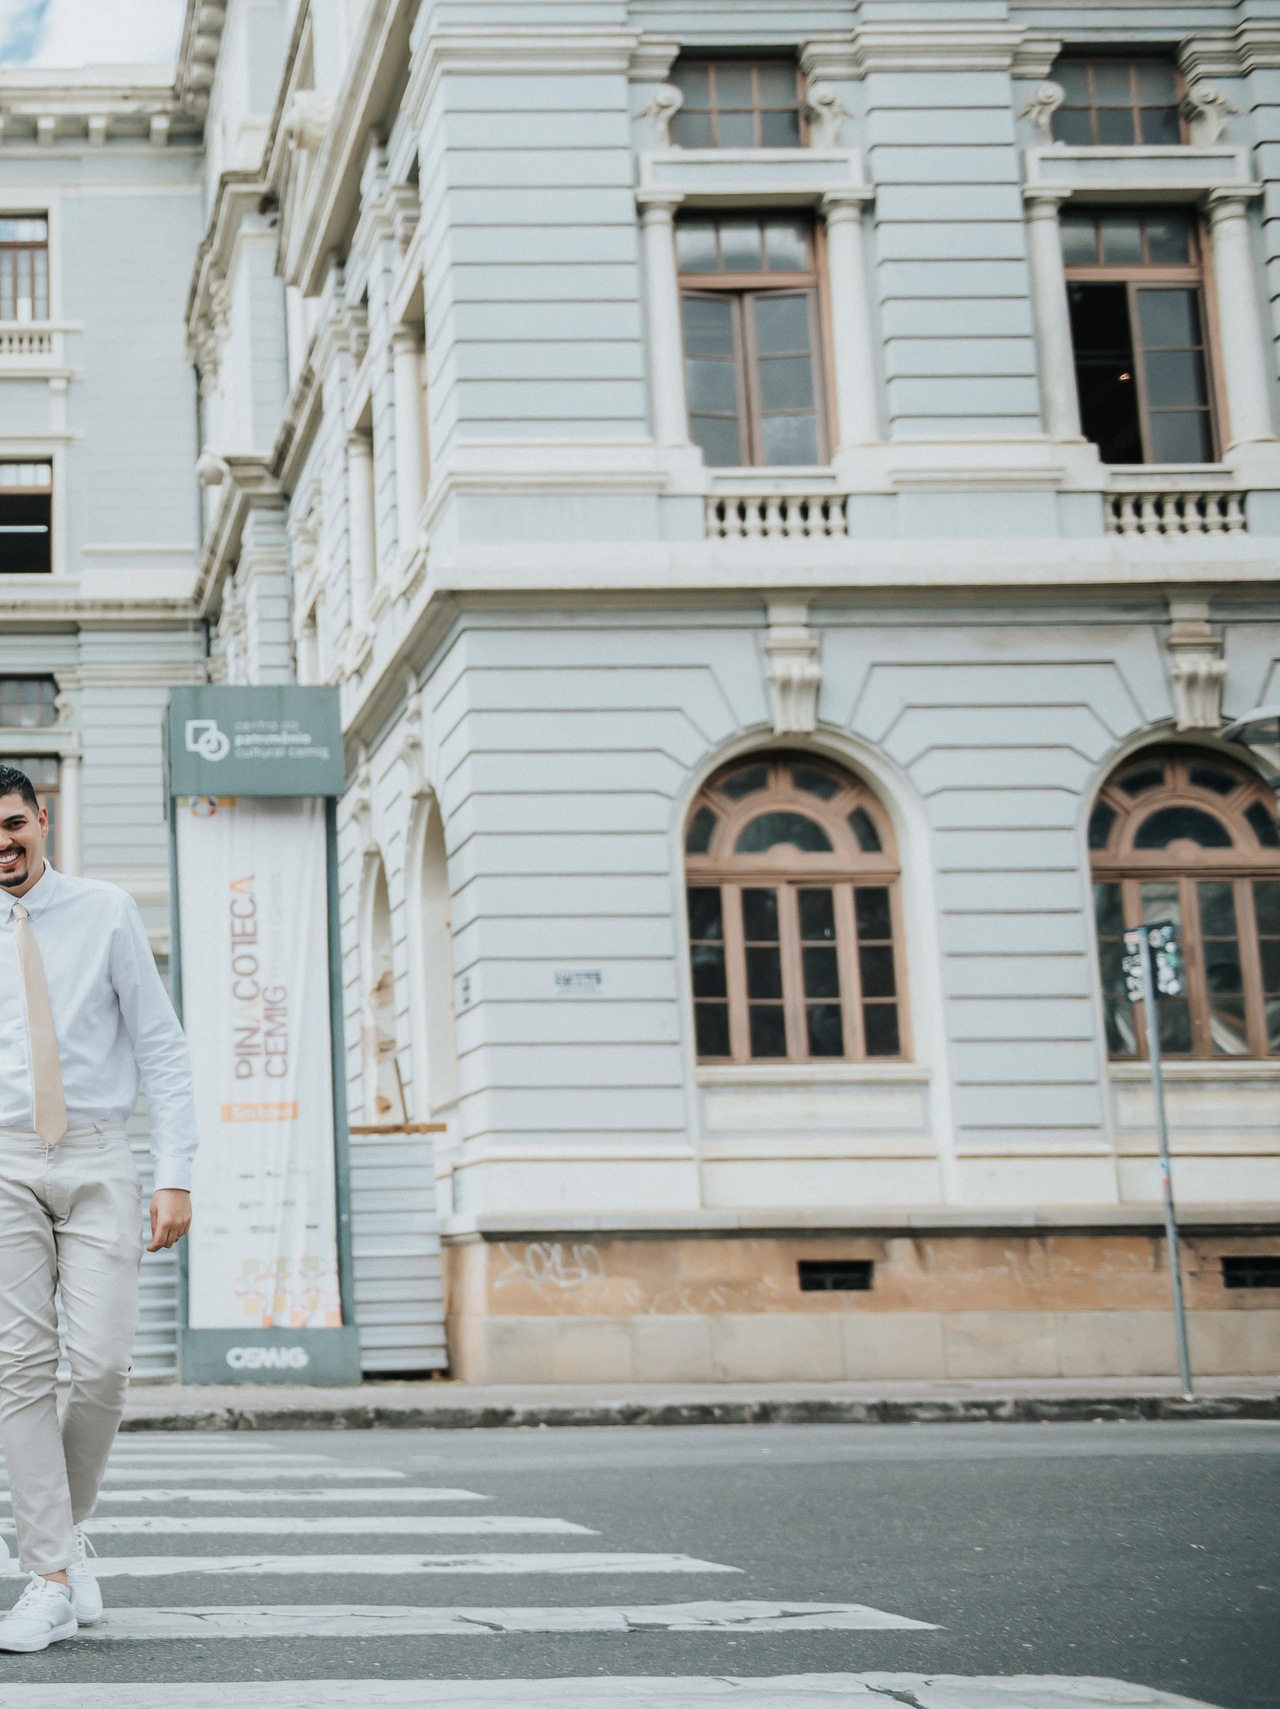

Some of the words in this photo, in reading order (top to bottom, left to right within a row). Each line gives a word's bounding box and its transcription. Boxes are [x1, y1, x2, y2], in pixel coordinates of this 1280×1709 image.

[234, 747, 286, 759] cultural
[287, 747, 330, 761] cemig
[229, 874, 262, 1080] PINACOTECA
[263, 985, 288, 1079] CEMIG
